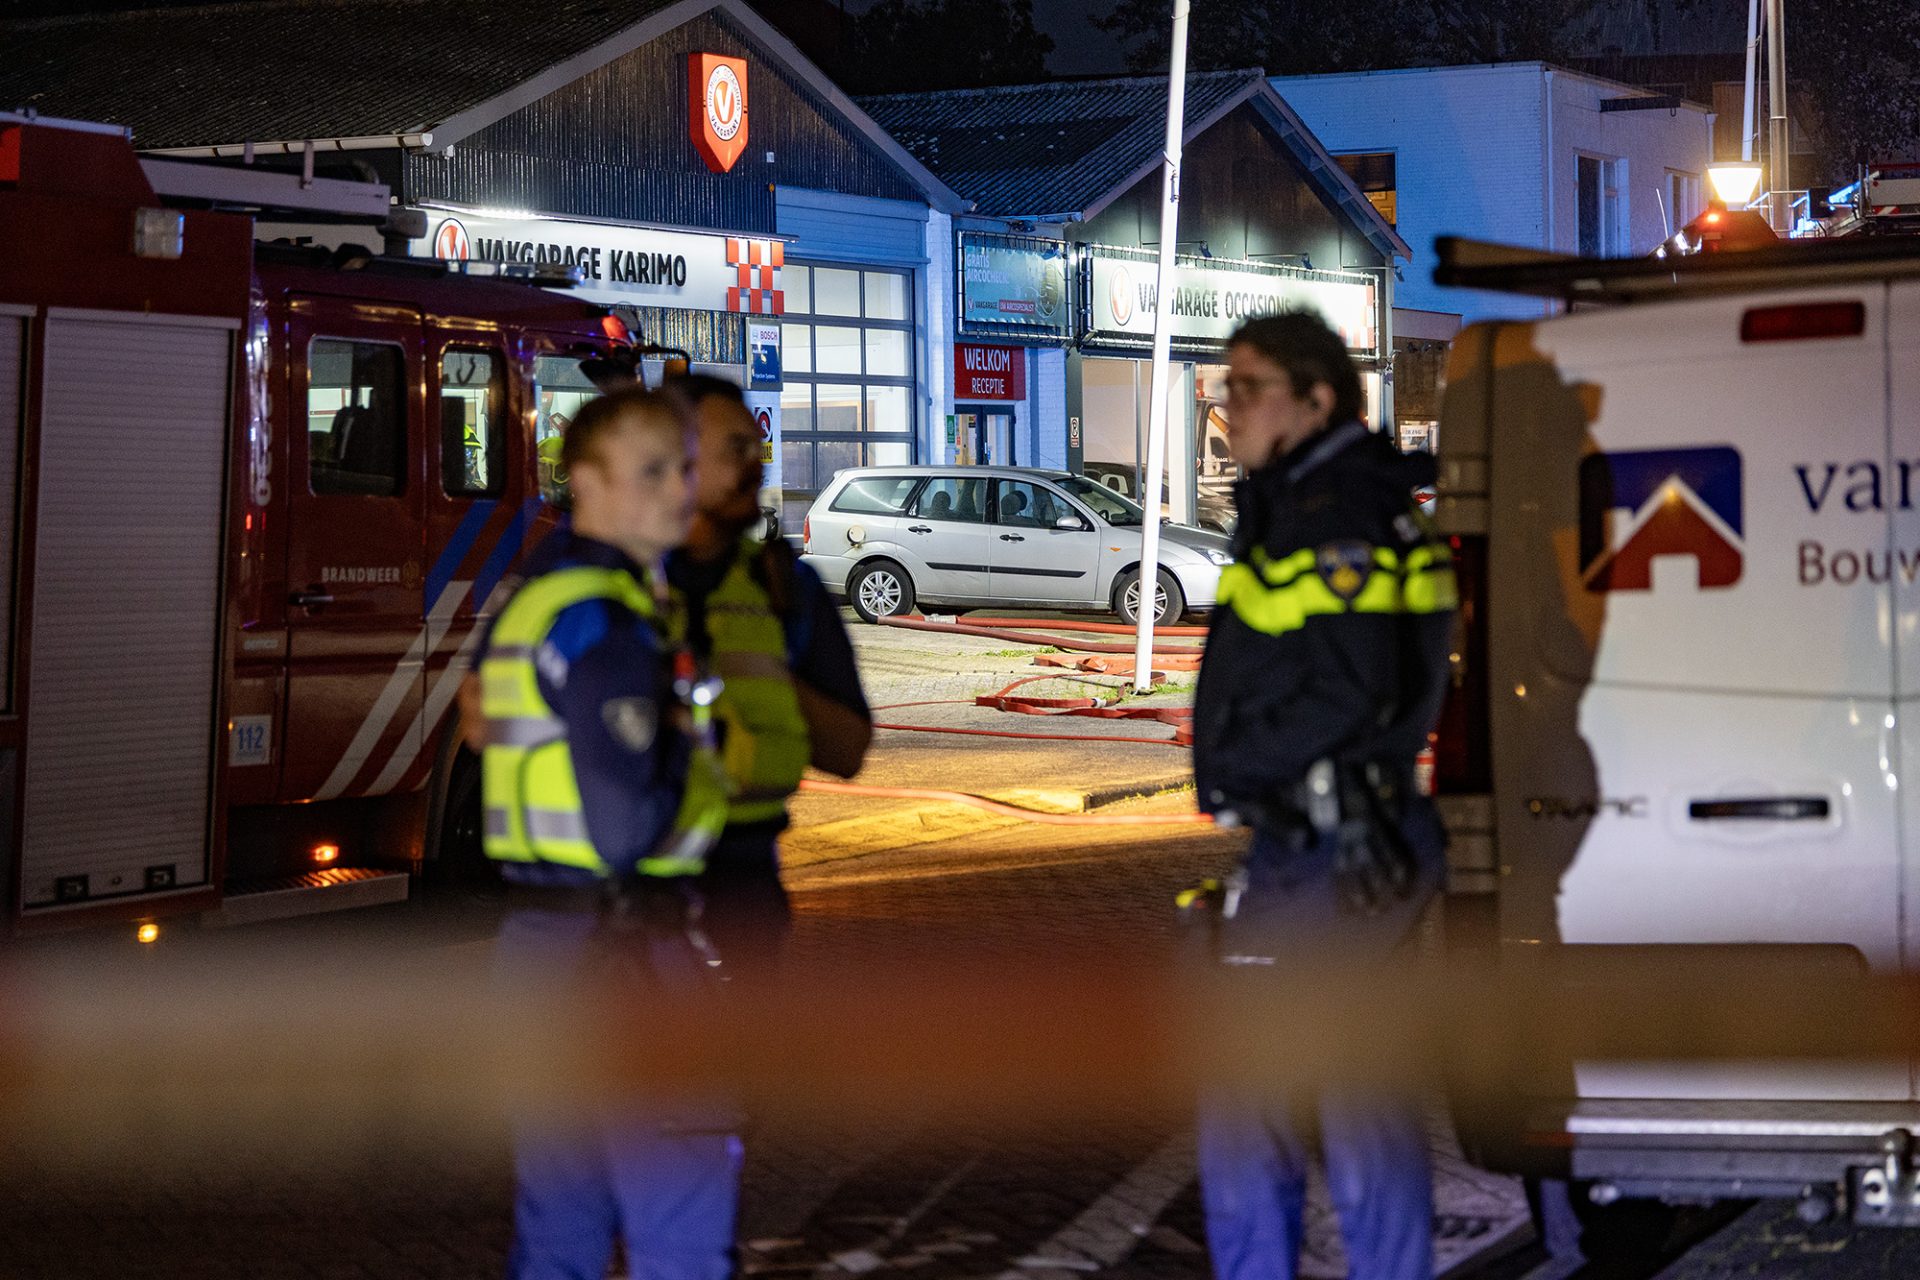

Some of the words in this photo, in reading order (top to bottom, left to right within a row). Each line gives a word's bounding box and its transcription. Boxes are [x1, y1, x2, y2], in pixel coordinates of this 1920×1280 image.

[610, 249, 687, 287] KARIMO
[966, 253, 990, 268] GRATIS
[1138, 282, 1218, 318] VAARAGE
[964, 347, 1010, 372] WELKOM
[971, 377, 1005, 394] RECEPTIE
[321, 566, 400, 583] BRANDWEER
[238, 725, 264, 750] 112
